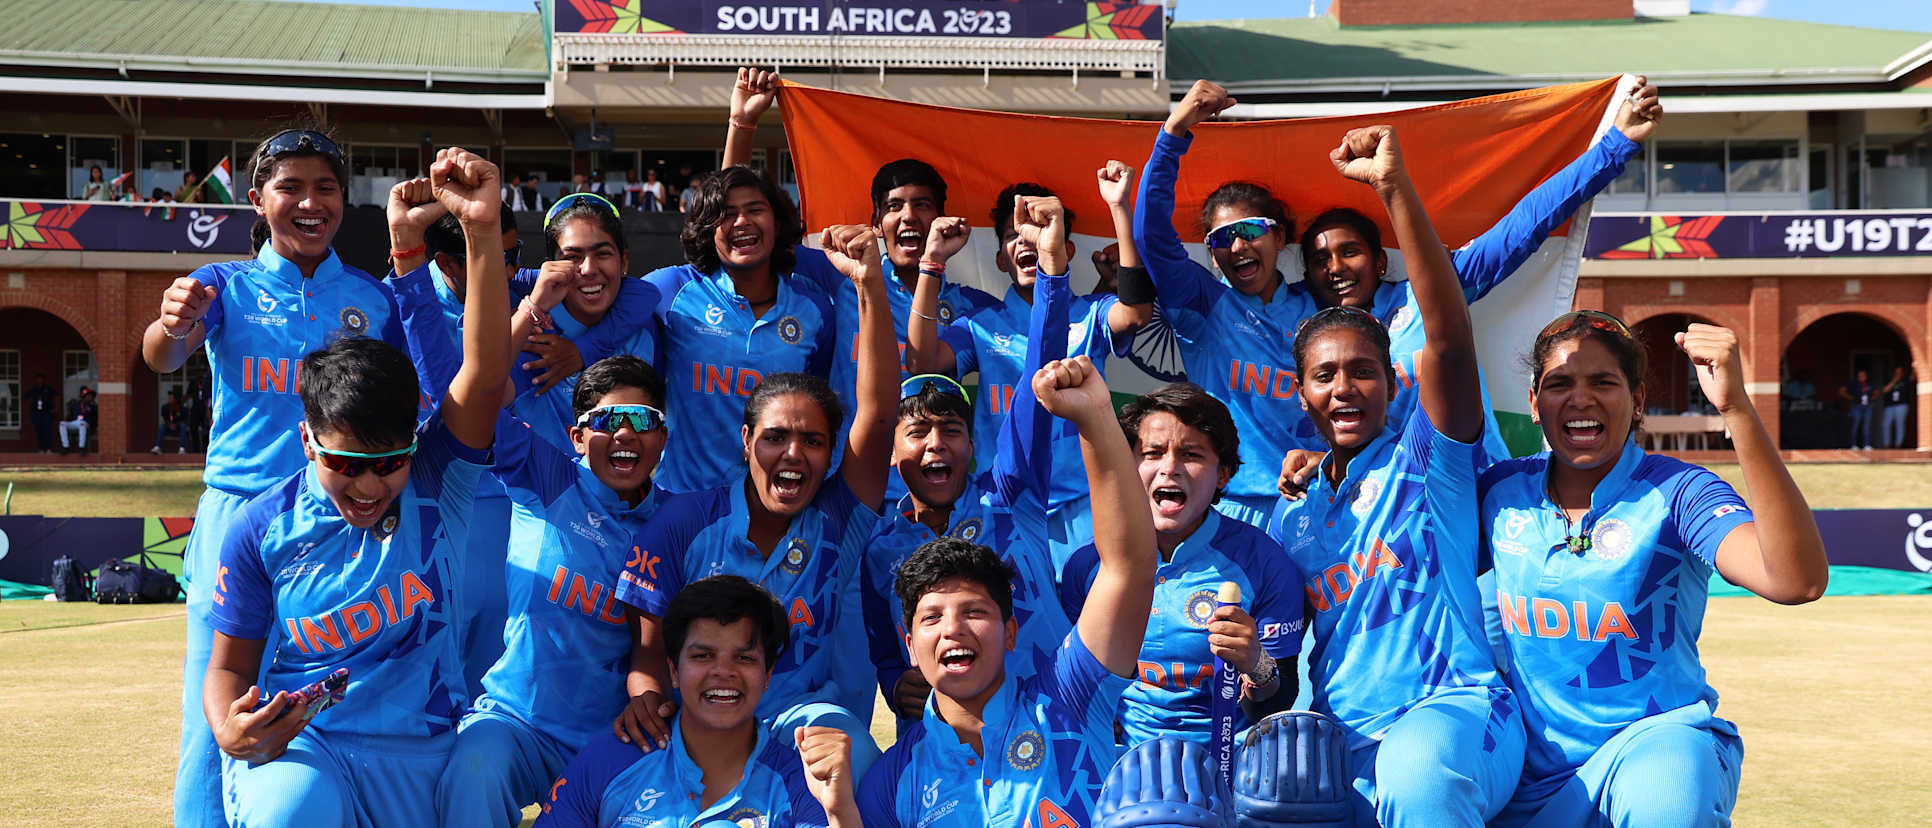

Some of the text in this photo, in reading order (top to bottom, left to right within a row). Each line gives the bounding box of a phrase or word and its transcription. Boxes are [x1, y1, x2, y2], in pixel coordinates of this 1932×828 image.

[716, 6, 819, 31] SOUTH
[826, 8, 936, 33] AFRICA
[692, 361, 762, 396] IND
[1229, 358, 1297, 399] IND
[1304, 533, 1404, 613] NDIA
[285, 569, 434, 654] INDIA
[547, 564, 628, 624] IND
[1137, 659, 1214, 690] DIA
